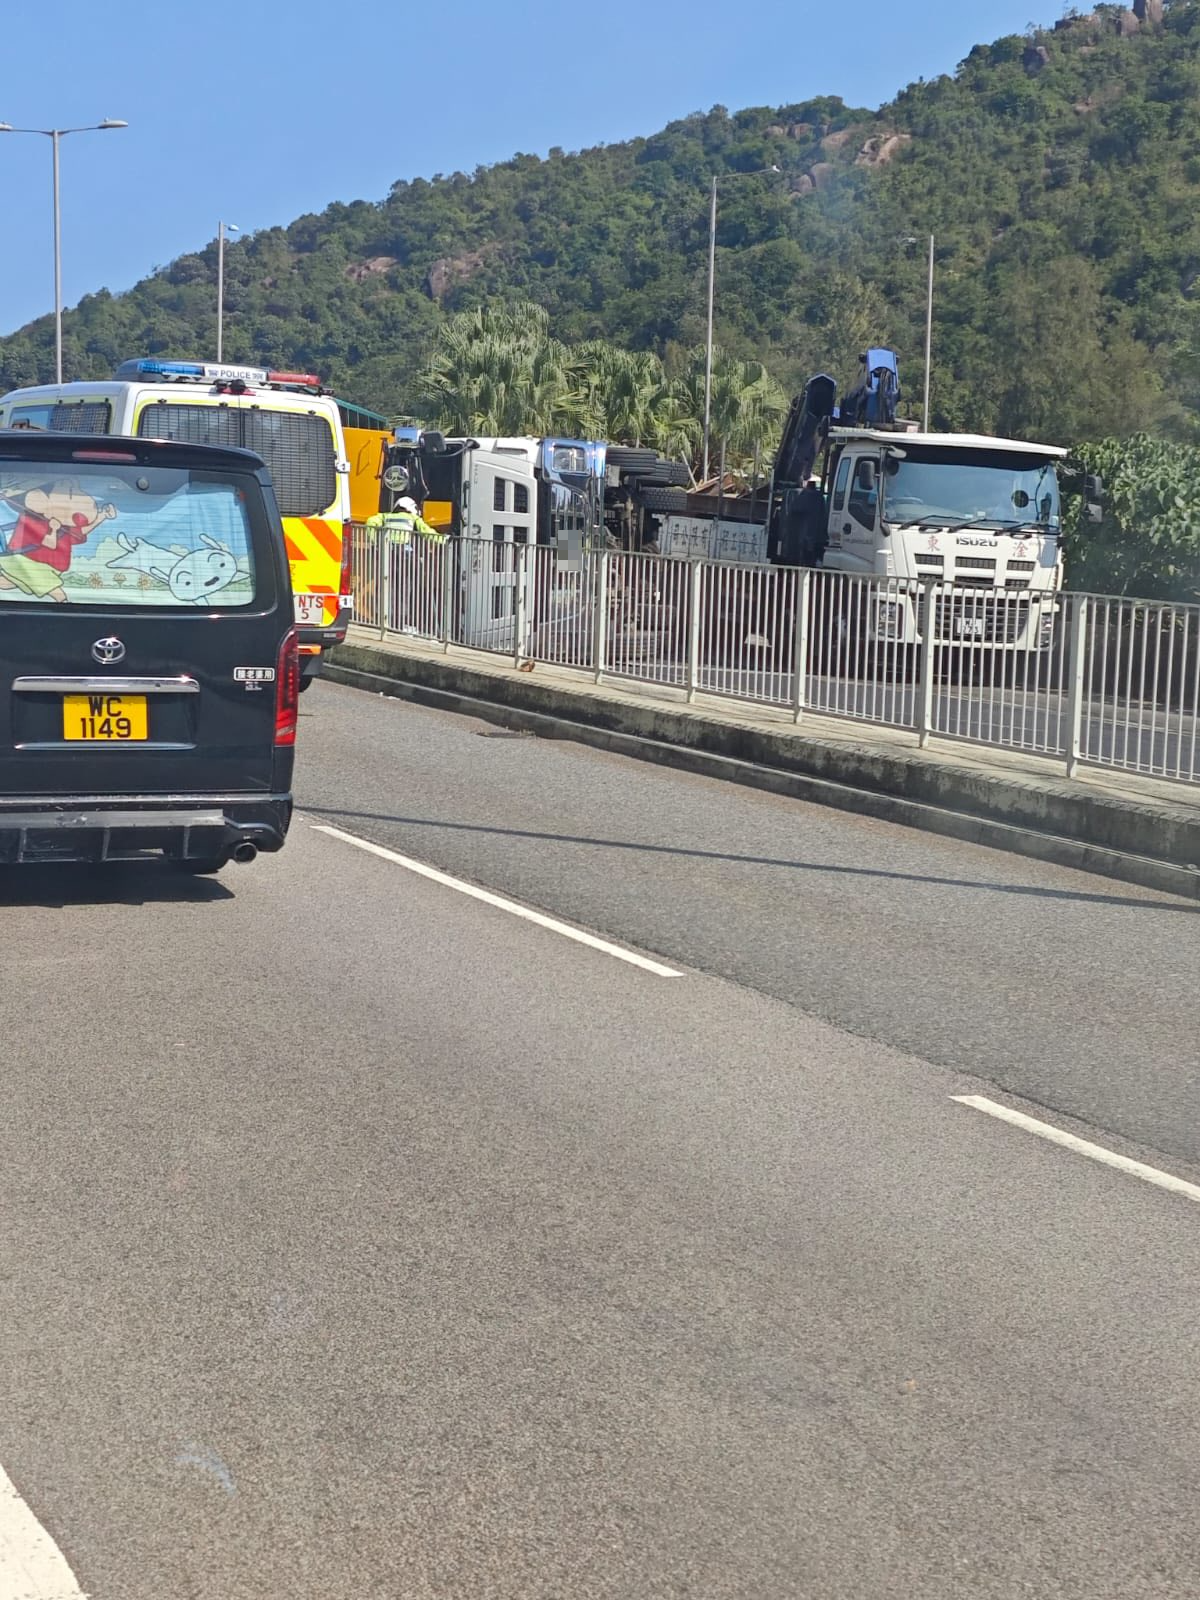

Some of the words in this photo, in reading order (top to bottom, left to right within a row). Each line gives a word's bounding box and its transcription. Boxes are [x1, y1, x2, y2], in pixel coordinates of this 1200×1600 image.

[220, 369, 252, 379] POLICE
[927, 535, 940, 552] 東
[956, 537, 998, 548] ISUZU
[298, 595, 324, 608] NTS
[301, 608, 310, 620] 5
[87, 696, 122, 717] WC
[80, 717, 132, 738] 1149
